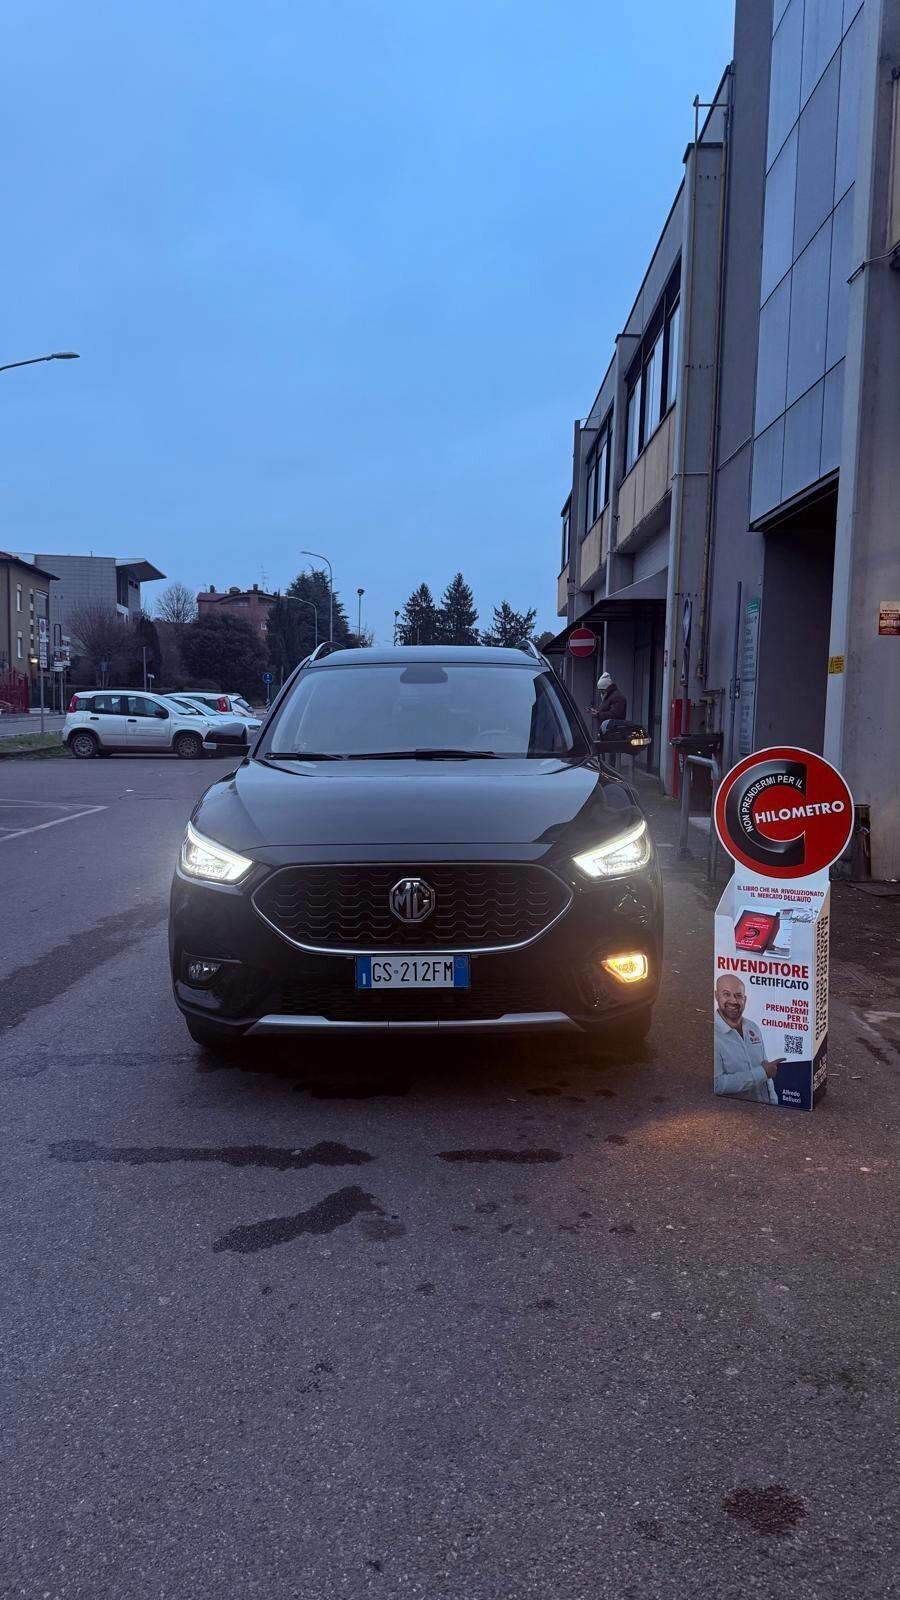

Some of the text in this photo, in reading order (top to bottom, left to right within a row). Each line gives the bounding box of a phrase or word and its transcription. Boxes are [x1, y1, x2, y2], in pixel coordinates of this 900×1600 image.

[742, 775, 803, 832] NON PRENDERMI PER IL
[781, 889, 824, 898] RIVOLUZIONATO
[394, 882, 431, 918] MG
[717, 956, 809, 979] RIVENDITORE
[750, 976, 809, 990] CERTIFICATO
[766, 1004, 808, 1015] PRENDERMI
[792, 1000, 808, 1008] NON
[787, 1014, 801, 1023] PER
[762, 1019, 808, 1031] CHILOMETRO
[782, 1088, 800, 1097] Alfredo
